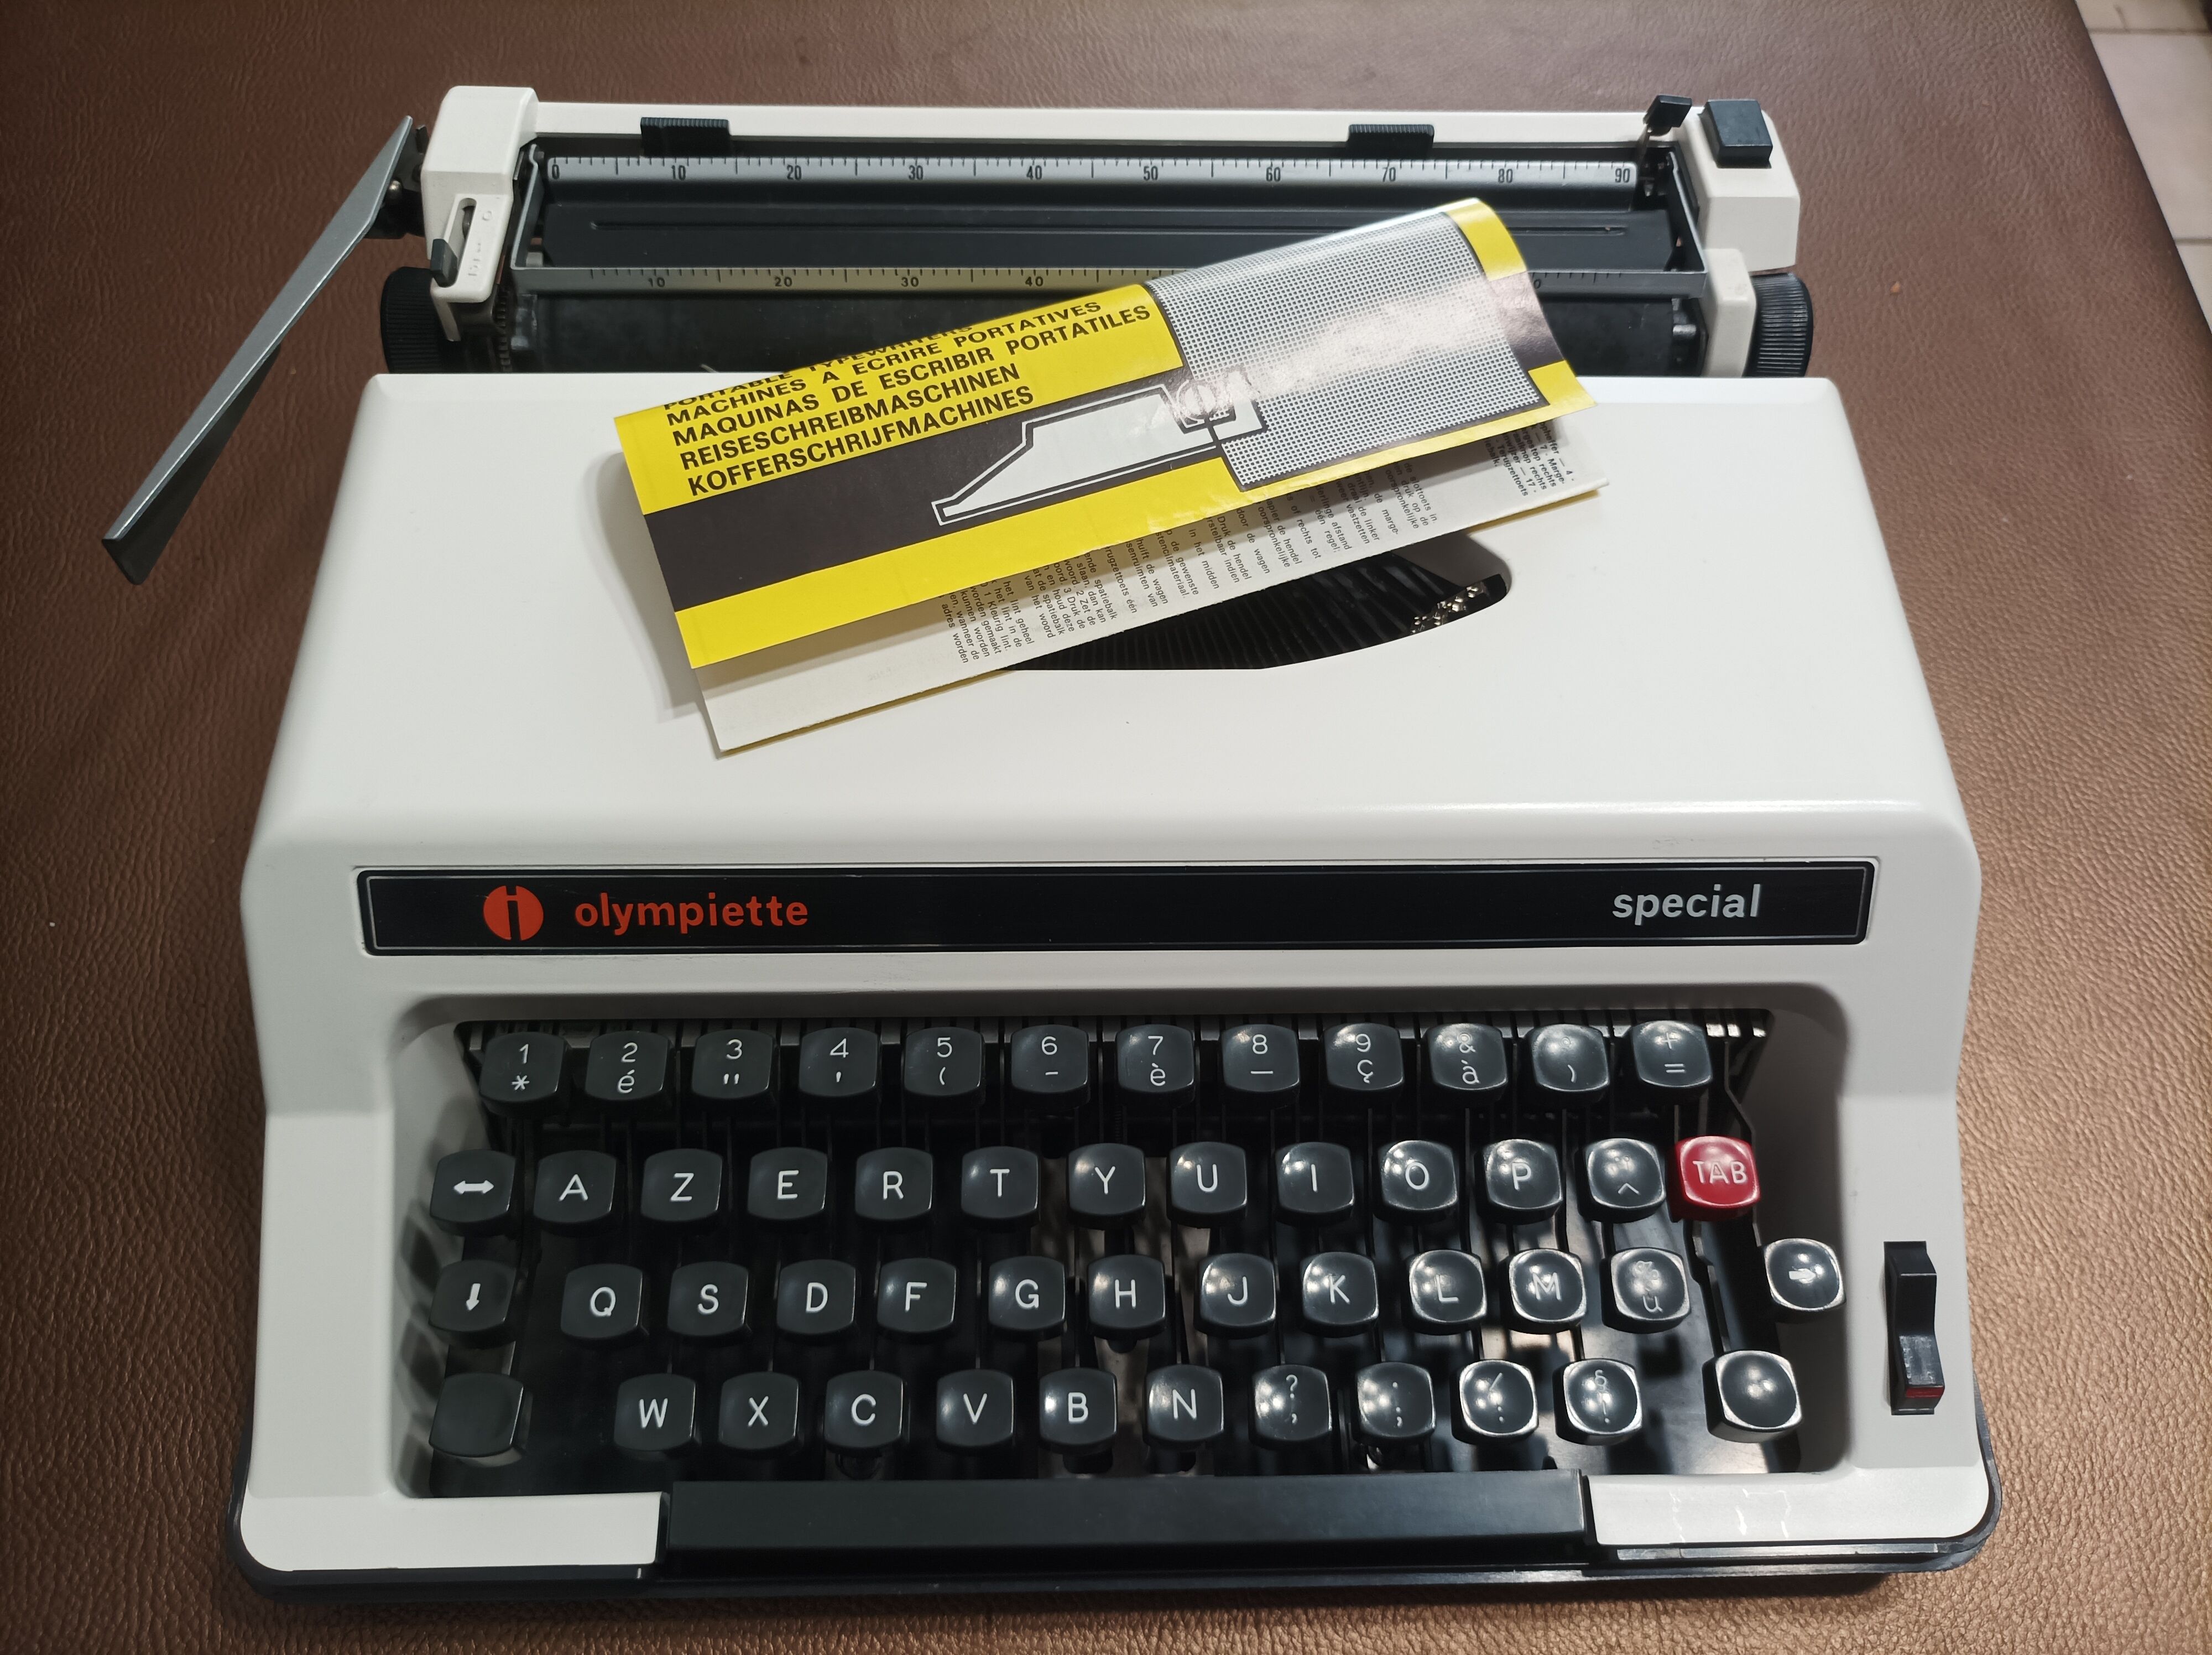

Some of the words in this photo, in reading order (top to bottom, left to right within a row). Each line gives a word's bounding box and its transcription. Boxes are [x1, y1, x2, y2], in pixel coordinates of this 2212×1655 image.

[552, 165, 560, 180] 0
[671, 165, 686, 181] 10
[787, 165, 802, 181] 20
[909, 165, 924, 181] 30
[1026, 165, 1042, 180] 40
[1144, 165, 1159, 181] 50
[1266, 166, 1281, 182] 60
[1382, 166, 1397, 183] 70
[1498, 168, 1514, 184] 80
[1614, 168, 1631, 184] 90
[649, 277, 666, 288] 10
[775, 277, 793, 288] 20
[901, 277, 920, 288] 30
[1025, 277, 1044, 288] 40
[667, 379, 806, 426] MACHINES
[823, 371, 840, 384] A
[852, 342, 942, 375] ECRIRE
[953, 302, 1101, 347] PORTATIVES
[672, 394, 819, 446] MAQUINAS
[832, 380, 868, 403] DE
[879, 347, 994, 390] ESCRIBIR
[1005, 305, 1150, 355] PORTATILES
[680, 363, 1020, 470] REISESCHREIBMASCHINEN
[688, 386, 1034, 496] KOFFERSCHRIJFMACHINES
[1375, 493, 1383, 503] de
[1385, 470, 1419, 529] oorspronkelijke
[1346, 504, 1371, 544] vastzetten
[1358, 507, 1366, 517] de
[1364, 519, 1380, 541] linker
[1412, 503, 1421, 513] op
[1420, 516, 1429, 526] de
[1217, 516, 1232, 537] Druk
[1227, 540, 1236, 550] de
[1233, 553, 1253, 580] hendel
[1258, 507, 1290, 568] oorspronkelijke
[1277, 525, 1286, 535] de
[1284, 538, 1302, 564] hendel
[1297, 519, 1313, 544] rechts
[1311, 548, 1322, 559] tot
[1331, 522, 1353, 550] afstand
[1170, 541, 1180, 552] de
[1176, 557, 1199, 595] gewenste
[1188, 528, 1196, 538] in
[1193, 542, 1205, 556] het
[1202, 560, 1219, 589] midden
[1246, 533, 1255, 543] de
[1254, 548, 1270, 574] wagen
[1104, 547, 1129, 596] rugzettoets
[1146, 564, 1155, 574] de
[1152, 578, 1168, 604] wagen
[1224, 559, 1240, 583] indien
[1003, 581, 1015, 596] het
[1010, 599, 1021, 614] lint
[1016, 617, 1035, 644] geheel
[1024, 575, 1035, 591] van
[1031, 595, 1042, 609] het
[1039, 613, 1056, 638] woord
[1037, 580, 1047, 591] de
[1042, 594, 1065, 636] spatiebalk
[1046, 574, 1055, 586] en
[1052, 589, 1067, 610] houd
[1062, 613, 1074, 632] deze
[1067, 596, 1081, 617] Druk
[1076, 619, 1086, 629] de
[1080, 598, 1091, 613] Zet
[1087, 615, 1096, 626] de
[1088, 591, 1099, 606] dan
[1095, 608, 1106, 623] kan
[1094, 579, 1118, 620] spatiebalk
[1147, 593, 1158, 607] van
[960, 590, 977, 622] kunnen
[974, 627, 990, 657] worden
[987, 600, 1004, 632] Kleurig
[994, 587, 1006, 603] het
[1001, 606, 1013, 622] lint
[1009, 625, 1016, 634] in
[1013, 637, 1022, 648] de
[941, 603, 956, 628] adres
[952, 633, 968, 663] worden
[956, 610, 974, 647] wanneer
[971, 649, 980, 660] de
[981, 620, 1002, 654] gemaakt
[575, 892, 808, 936] olympiette
[1613, 883, 1761, 925] special
[519, 1044, 530, 1064] 1
[621, 1042, 638, 1063] 2
[726, 1039, 743, 1060] 3
[830, 1038, 849, 1058] 4
[937, 1037, 952, 1058] 5
[1041, 1036, 1057, 1055] 6
[1147, 1035, 1164, 1055] 7
[1252, 1034, 1268, 1055] 8
[1355, 1033, 1371, 1053] 9
[617, 1069, 635, 1094] é
[1150, 1063, 1166, 1086] è
[1461, 1059, 1480, 1084] à
[559, 1174, 588, 1201] A
[670, 1173, 695, 1201] Z
[777, 1169, 800, 1199] E
[883, 1171, 904, 1200] R
[990, 1169, 1010, 1197] T
[1094, 1166, 1115, 1195] Y
[1196, 1164, 1218, 1193] U
[1405, 1162, 1430, 1190] O
[1511, 1162, 1532, 1191] P
[1692, 1160, 1748, 1185] TAB
[698, 1284, 719, 1314] S
[805, 1282, 828, 1313] D
[905, 1282, 927, 1312] F
[1015, 1279, 1039, 1309] G
[1114, 1279, 1136, 1309] H
[1227, 1276, 1249, 1305] J
[1329, 1274, 1350, 1304] K
[1437, 1274, 1459, 1303] L
[1533, 1272, 1562, 1300] M
[590, 1286, 616, 1317] Q
[639, 1398, 668, 1428] W
[748, 1396, 769, 1427] X
[851, 1394, 876, 1425] C
[963, 1393, 987, 1424] V
[1068, 1392, 1088, 1423] B
[1172, 1388, 1197, 1420] N
